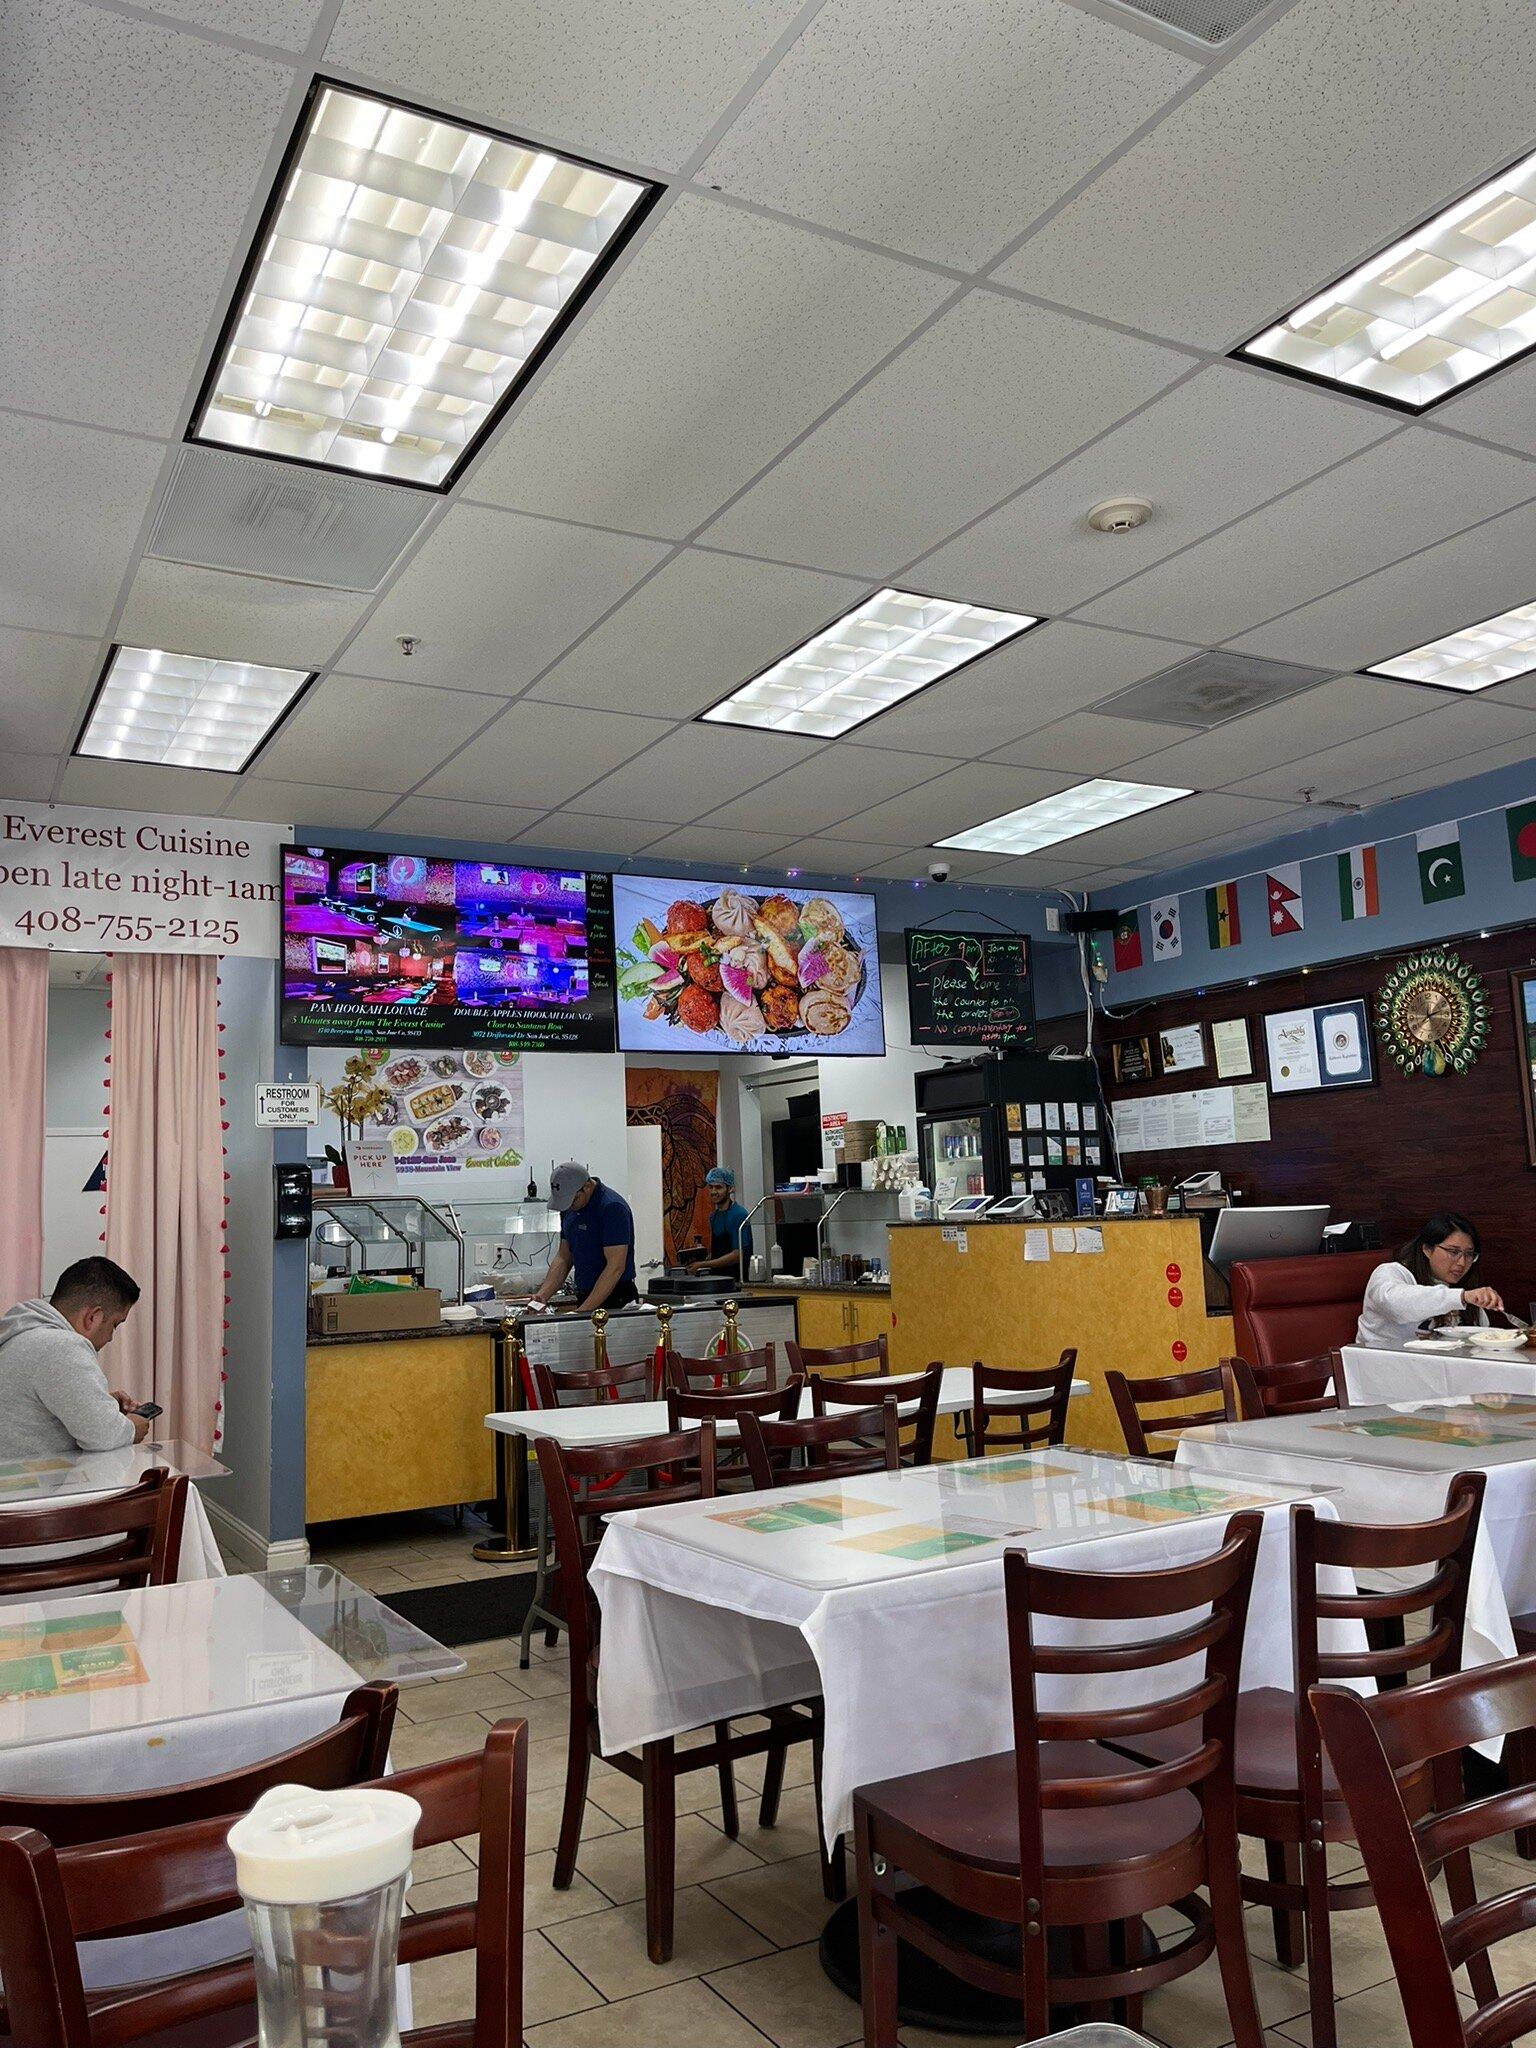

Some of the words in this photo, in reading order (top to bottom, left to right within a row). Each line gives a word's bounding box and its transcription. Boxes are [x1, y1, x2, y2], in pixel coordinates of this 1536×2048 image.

[3, 814, 127, 849] Everest
[136, 826, 250, 858] Cuisine
[61, 861, 121, 891] late
[131, 868, 281, 902] night-1am
[15, 906, 240, 945] 408-755-2125
[310, 1002, 333, 1013] PAN
[334, 1003, 384, 1015] HOOKAH
[384, 1005, 429, 1017] LOUNGE
[453, 1008, 490, 1017] DOUBLE
[492, 1009, 523, 1019] APPLES
[523, 1010, 560, 1020] HOOKAH
[560, 1011, 594, 1021] LOUNGE
[299, 1015, 331, 1025] Minutes
[331, 1018, 353, 1028] away
[354, 1017, 375, 1028] from
[377, 1018, 393, 1027] The
[487, 1020, 507, 1029] Close
[507, 1021, 515, 1029] to
[515, 1021, 546, 1030] Santana
[547, 1022, 564, 1031] Row
[266, 1088, 310, 1099] RESTROOM
